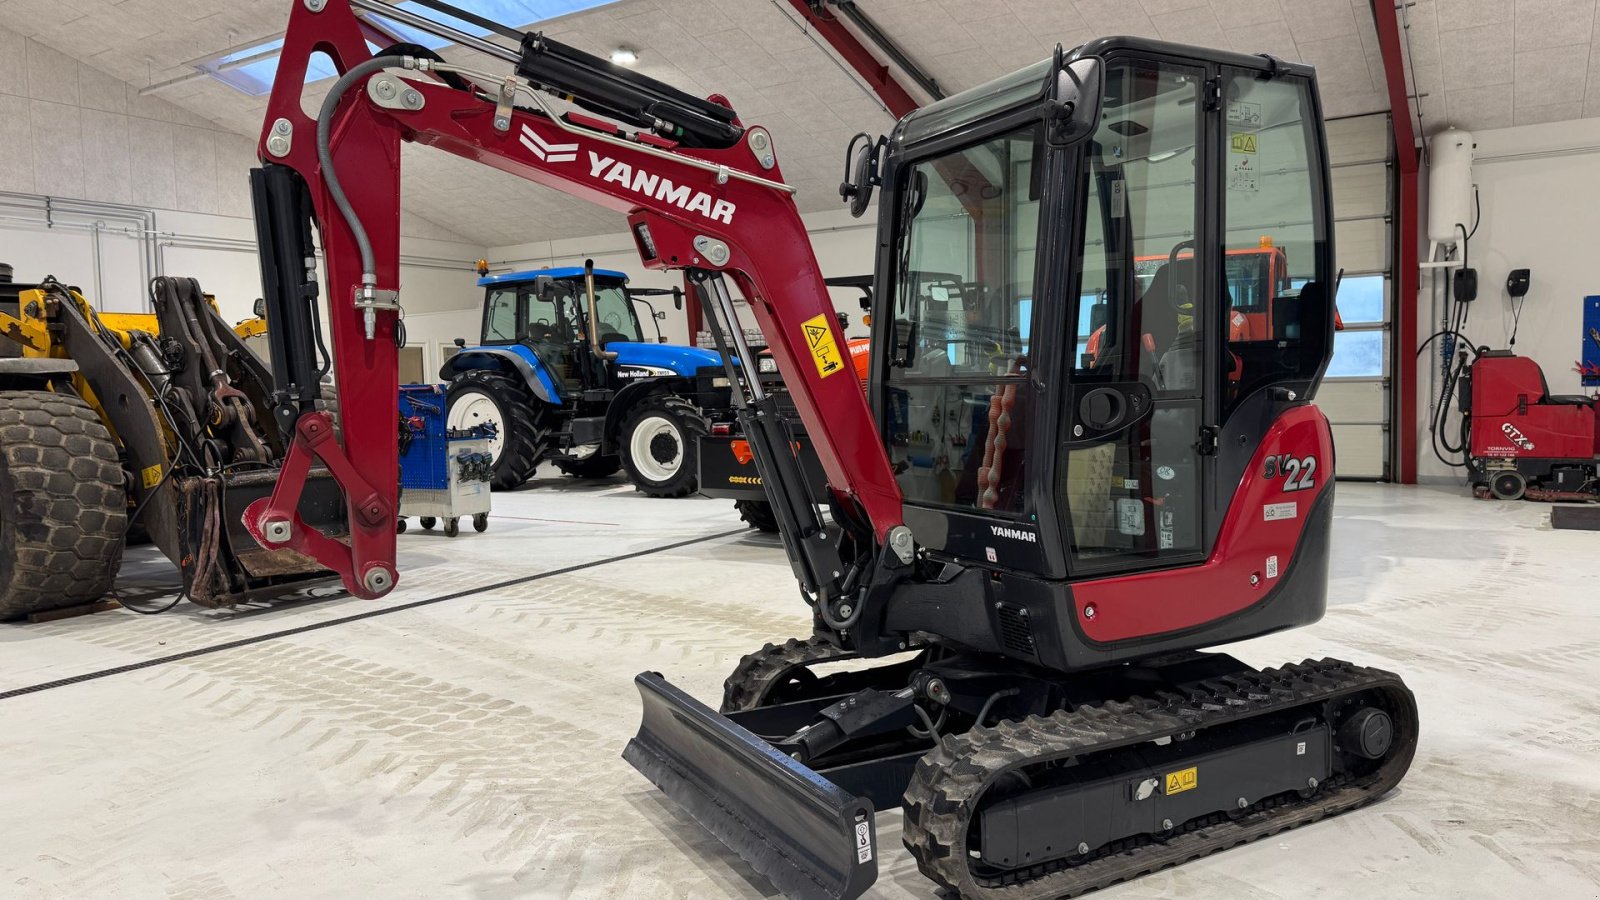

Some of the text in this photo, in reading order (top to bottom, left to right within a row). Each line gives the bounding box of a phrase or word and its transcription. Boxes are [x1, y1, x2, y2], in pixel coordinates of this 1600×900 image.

[588, 150, 736, 225] YANMAR
[1502, 423, 1527, 445] GTX
[990, 525, 1036, 543] YANMAR
